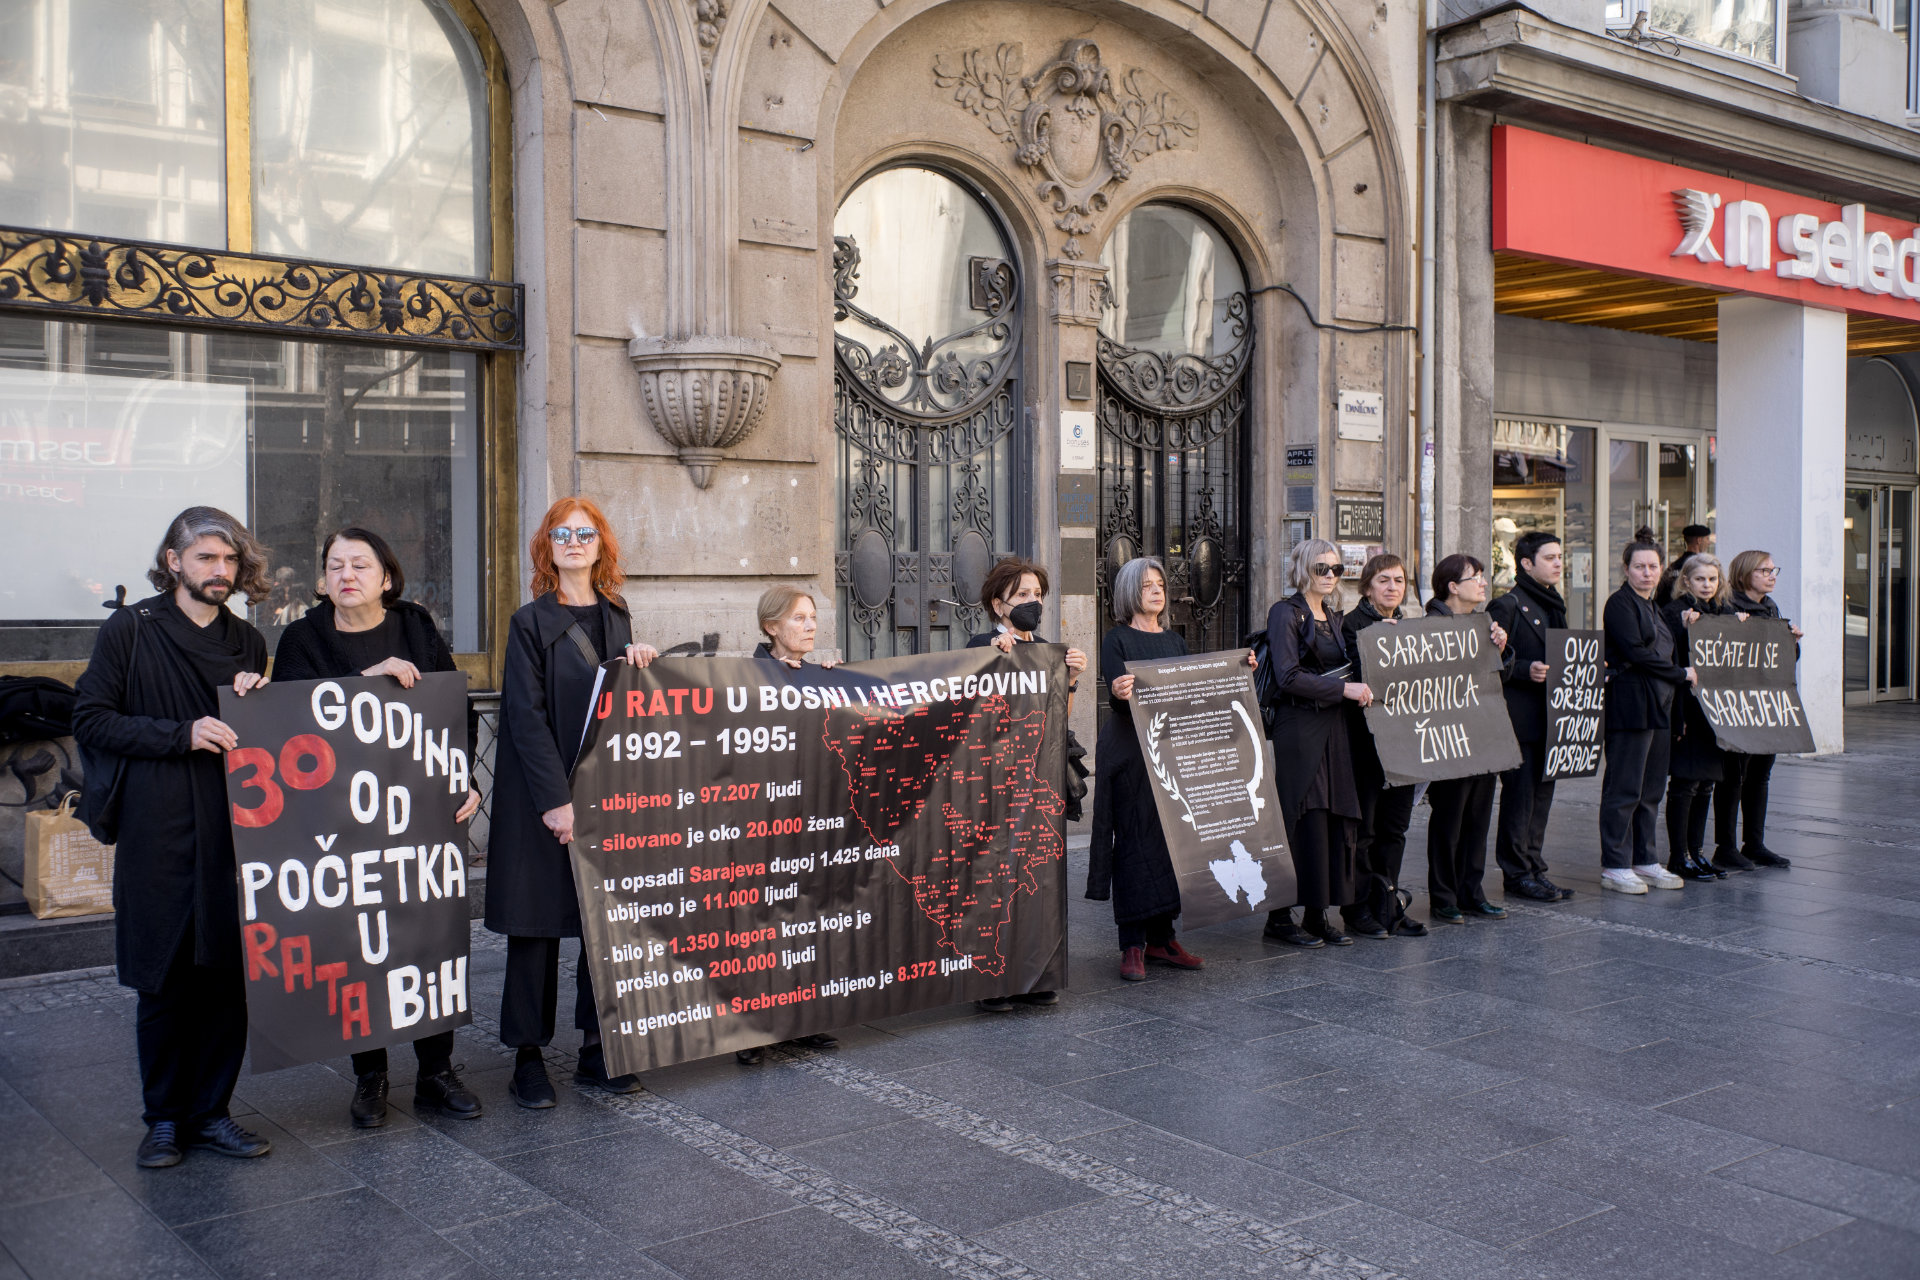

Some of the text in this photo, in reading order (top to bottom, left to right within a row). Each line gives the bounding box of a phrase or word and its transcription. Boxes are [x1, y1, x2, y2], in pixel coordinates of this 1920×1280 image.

[1776, 204, 1920, 302] selec
[1076, 374, 1084, 393] 7
[1376, 628, 1479, 668] SARAJEVO
[1564, 637, 1599, 662] OVO
[1695, 632, 1778, 668] SEĆATE LI SE
[597, 670, 1047, 720] U RATU U BOSNI I HERCEGOVINI
[1383, 673, 1480, 716] GROBNICA
[1562, 664, 1597, 687] SMO
[1550, 686, 1604, 711] DRŽALE
[1701, 688, 1800, 727] SARAJEVA
[312, 682, 468, 794] GODINA
[606, 730, 682, 762] 1992
[716, 726, 796, 755] 1995:
[1415, 718, 1471, 764] ŽIVIH
[1556, 714, 1600, 742] TOKOM
[228, 734, 336, 828] 30
[1546, 745, 1600, 776] OPSADE
[350, 770, 410, 836] OD
[602, 792, 672, 814] ubijeno
[677, 788, 695, 810] je
[700, 783, 760, 804] 97.207
[766, 780, 802, 802] ljudi
[602, 832, 682, 852] silovano
[686, 827, 704, 848] je
[709, 824, 740, 842] oko
[746, 817, 802, 838] 20.000
[807, 816, 845, 832] žena
[241, 834, 466, 921] POČETKA
[604, 878, 615, 892] u
[621, 868, 684, 893] opsadi
[690, 862, 766, 884] Sarajeva
[770, 853, 815, 875] dugoj
[820, 847, 860, 868] 1.425
[864, 844, 900, 861] dana
[607, 882, 798, 924] ubijeno je 11.000 ljudi
[358, 910, 389, 965] U
[612, 942, 642, 964] bilo
[648, 941, 664, 962] je
[669, 932, 720, 954] 1.350
[725, 927, 776, 948] logora
[781, 919, 816, 938] kroz
[820, 912, 853, 933] koje
[856, 910, 872, 930] je
[244, 922, 372, 1040] RATA
[386, 956, 468, 1030] BiH
[616, 946, 816, 998] prošlo oko 200.000 ljudi
[620, 1021, 632, 1035] u
[637, 1003, 712, 1036] genocidu
[716, 1003, 726, 1017] u
[731, 983, 816, 1014] Srebrenici
[821, 973, 876, 997] ubijeno
[879, 970, 894, 990] je
[898, 960, 936, 982] 8.372
[940, 954, 973, 976] ljudi
